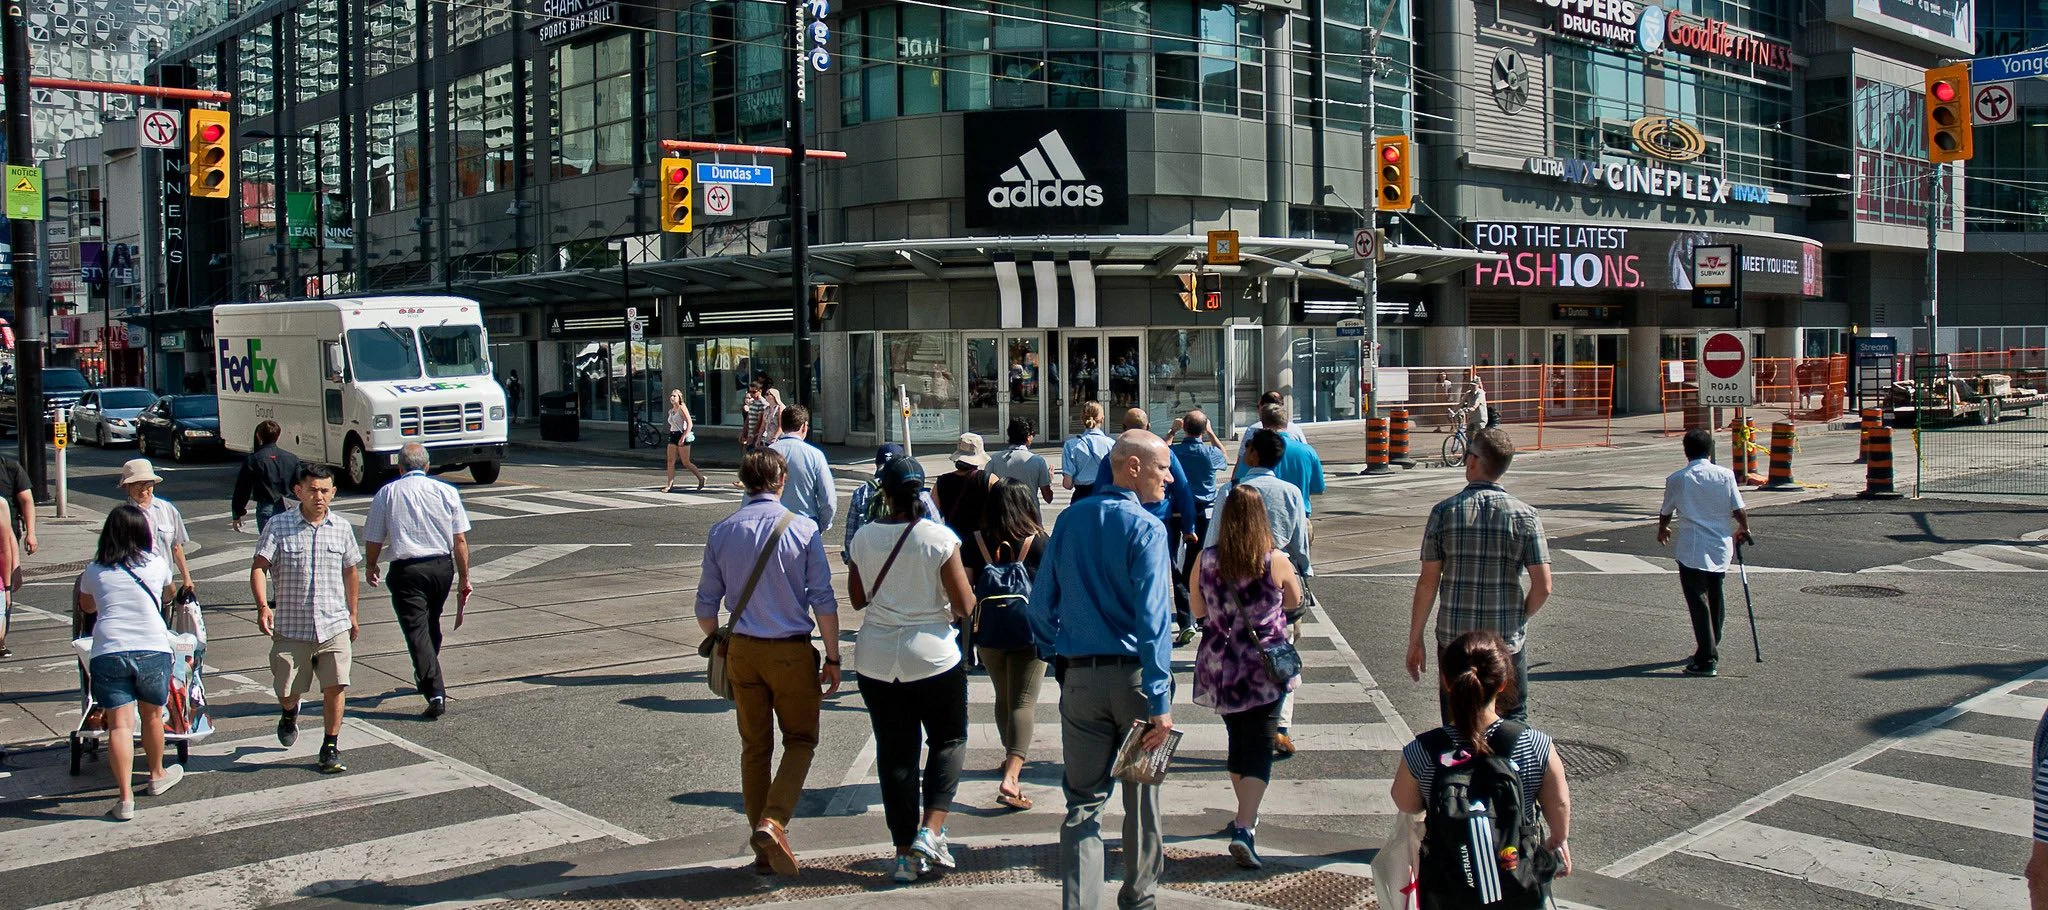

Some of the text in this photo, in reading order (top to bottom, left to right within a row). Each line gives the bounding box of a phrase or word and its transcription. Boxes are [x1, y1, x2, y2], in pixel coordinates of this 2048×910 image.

[540, 6, 610, 41] SPORTS BAR GRILL
[1563, 13, 1637, 44] DRUG MART
[1666, 9, 1793, 72] GoodLife FITNESS
[795, 7, 805, 101] DOWNTOWN
[2002, 57, 2048, 75] Yonge
[11, 168, 38, 177] NOTICE
[711, 166, 752, 181] Dundas
[1530, 157, 1565, 177] ULTRA
[1606, 162, 1770, 205] CINEPLEX IMAX
[987, 180, 1104, 208] adidas
[1476, 224, 1628, 249] FOR THE LATEST
[1742, 256, 1765, 272] MEET
[1766, 257, 1781, 273] YOU
[1207, 294, 1219, 309] 20
[219, 338, 279, 395] FedEx
[394, 382, 472, 394] FedEx
[1711, 382, 1739, 391] ROAD
[1706, 395, 1745, 404] CLOSED
[254, 403, 275, 419] Ground
[1461, 844, 1475, 889] AUSTRALIA
